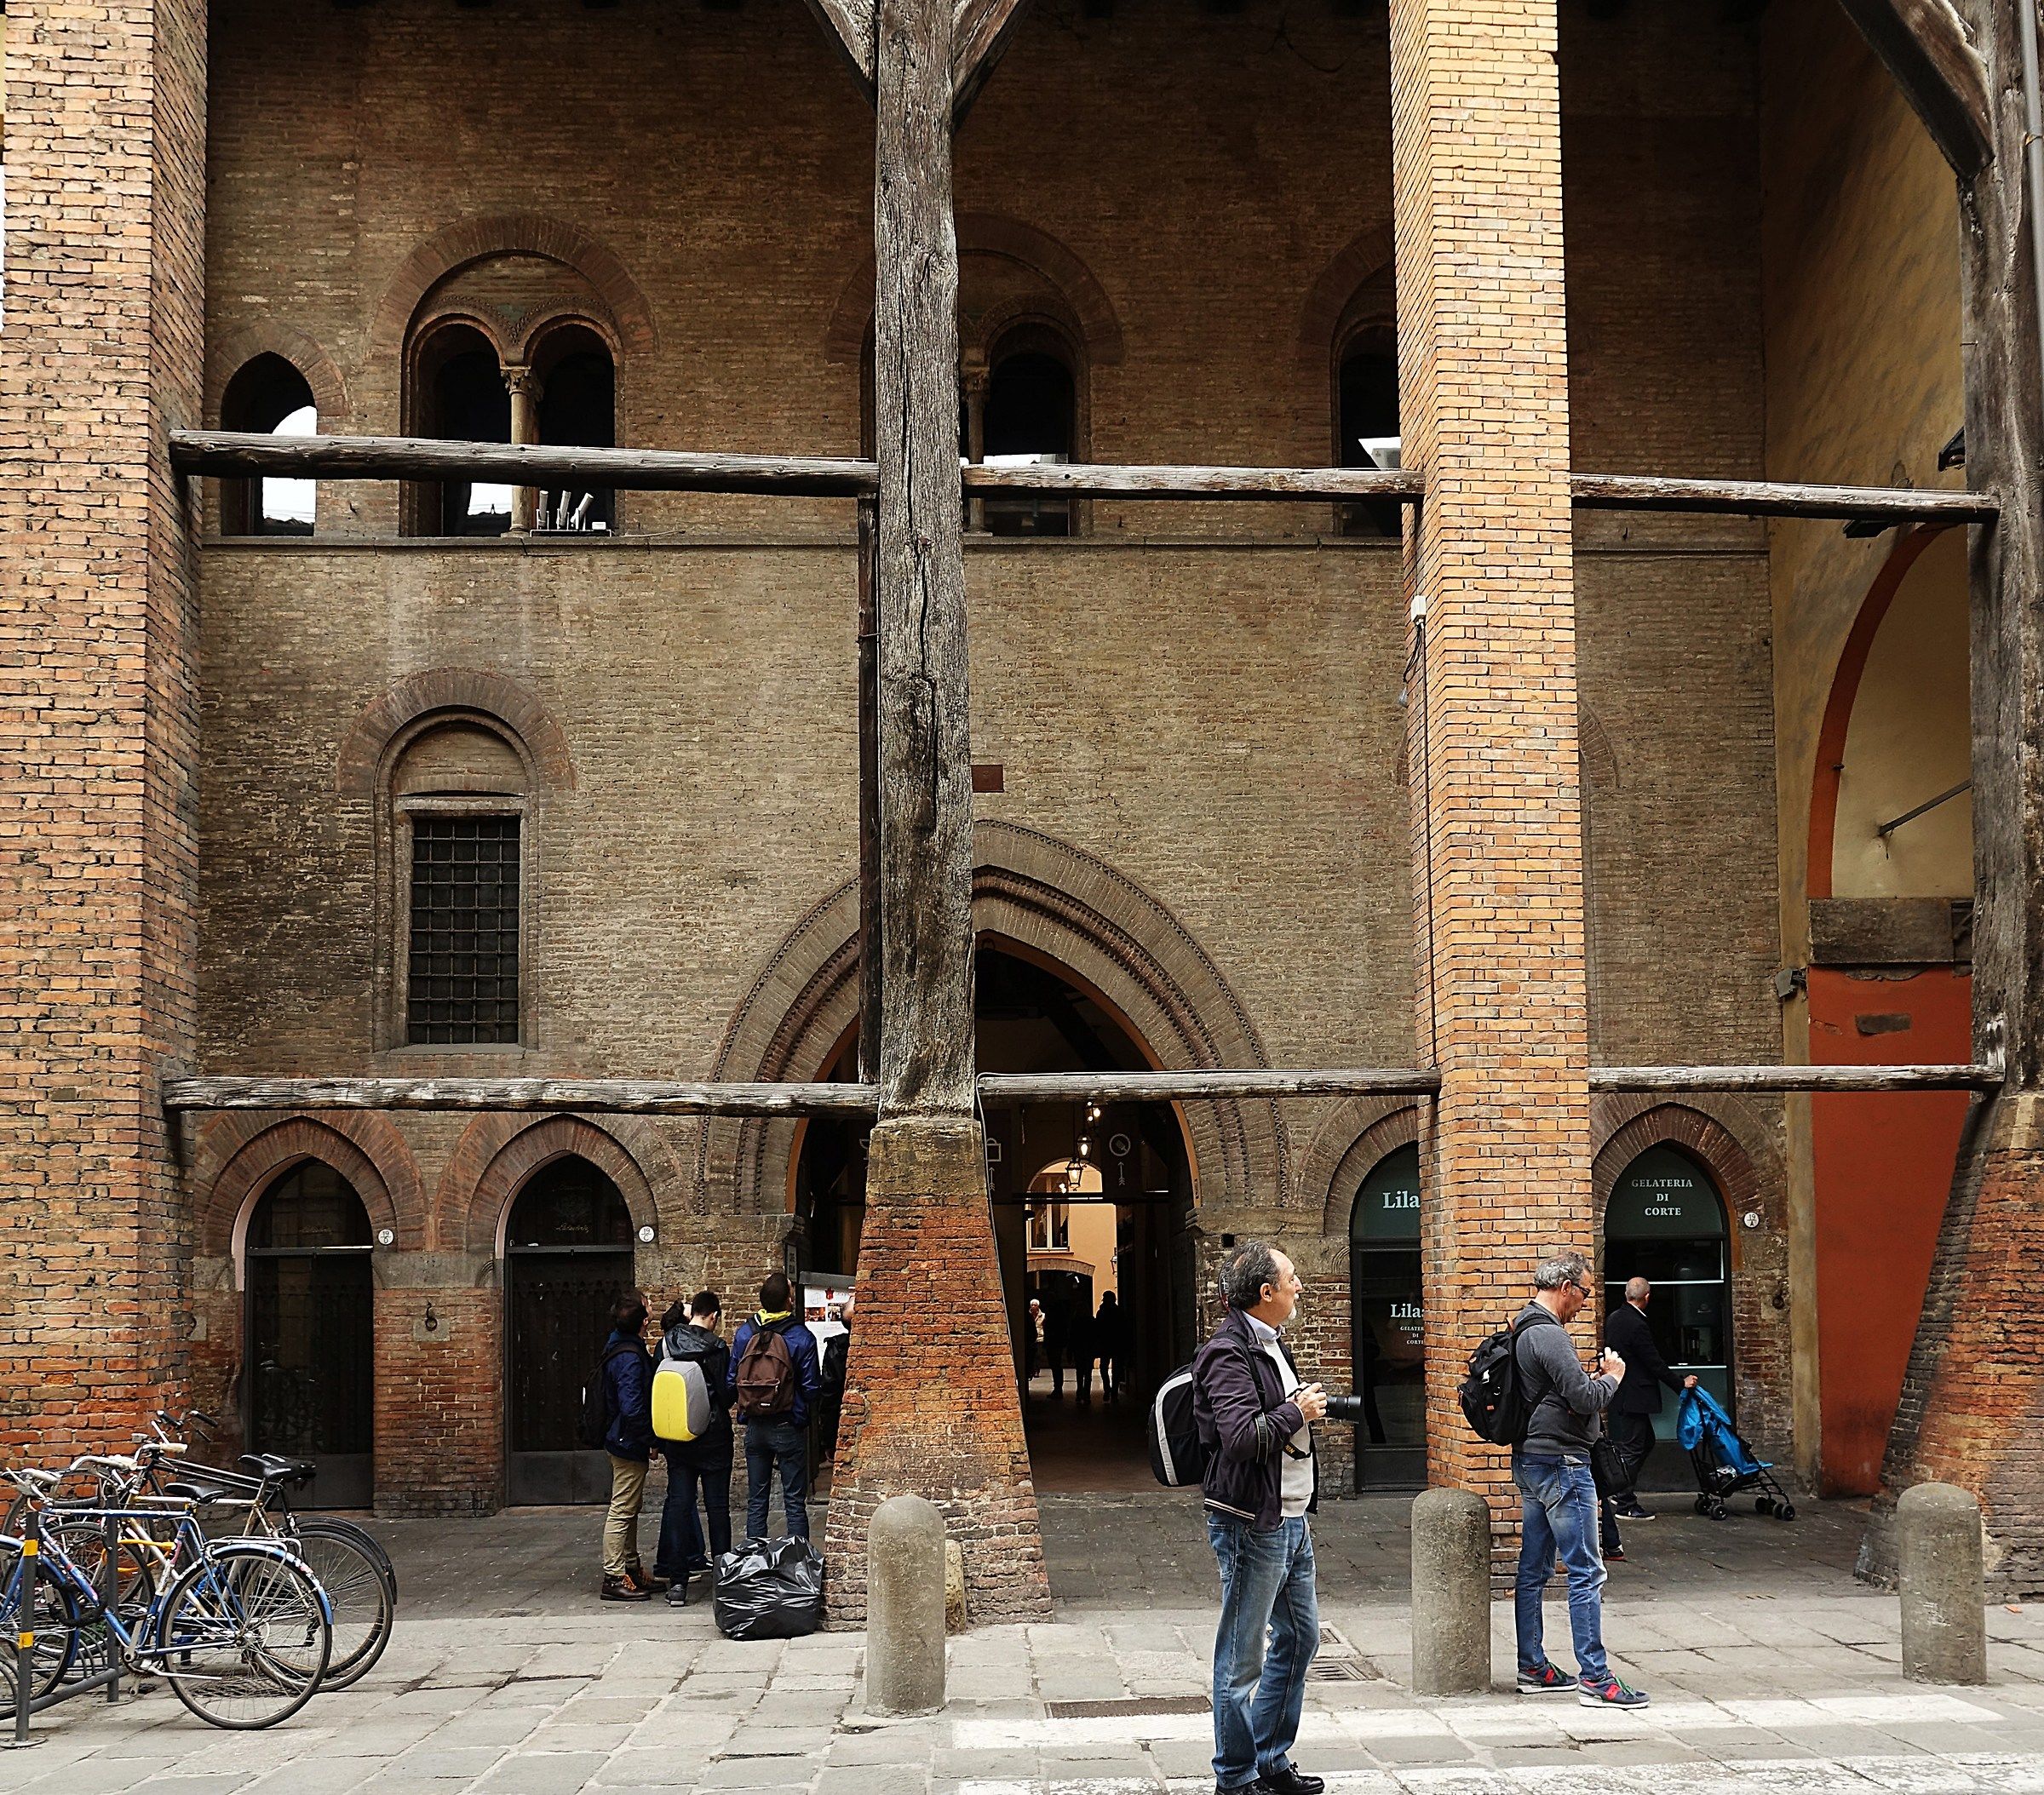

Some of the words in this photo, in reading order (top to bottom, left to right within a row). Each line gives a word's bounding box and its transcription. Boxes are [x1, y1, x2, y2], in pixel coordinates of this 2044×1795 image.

[1656, 1193, 1669, 1201] DI
[1645, 1207, 1681, 1216] CORTE
[1390, 1303, 1424, 1318] Lila
